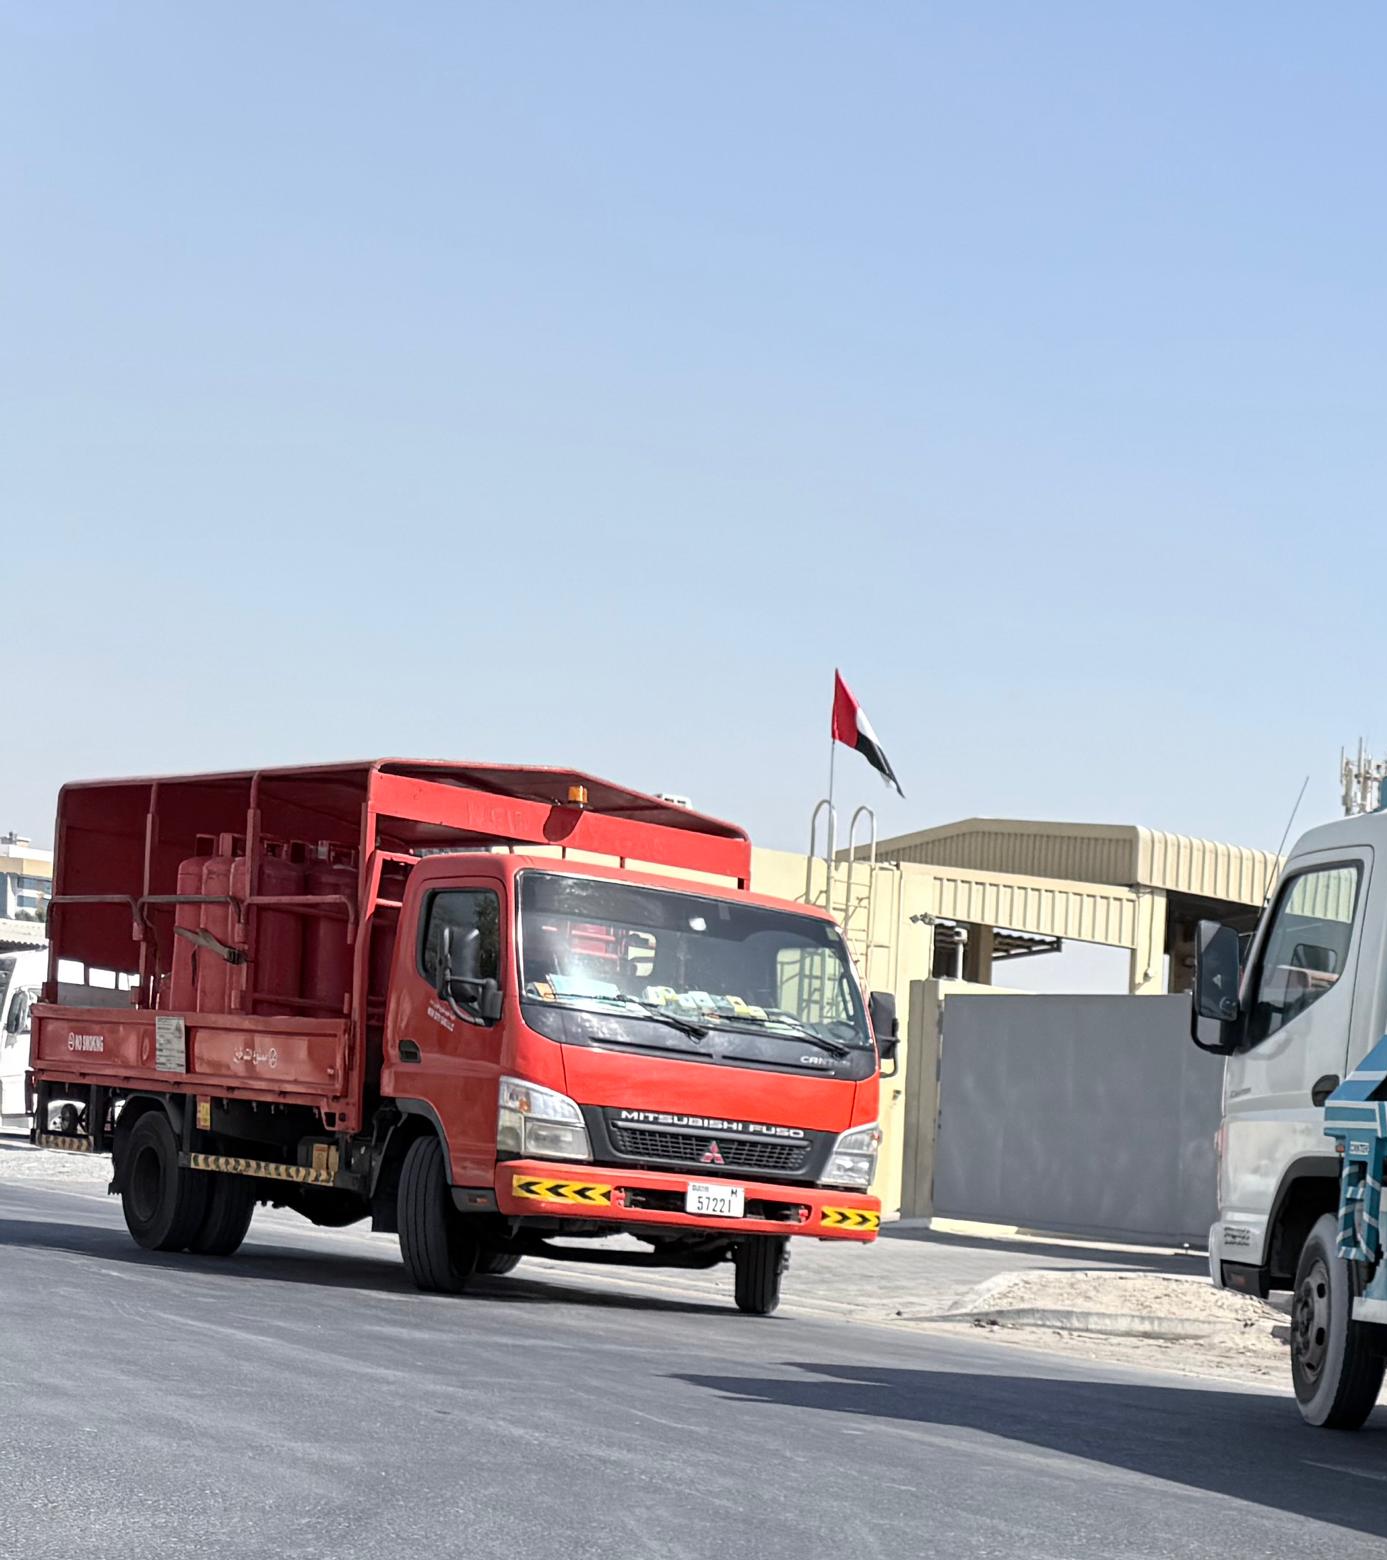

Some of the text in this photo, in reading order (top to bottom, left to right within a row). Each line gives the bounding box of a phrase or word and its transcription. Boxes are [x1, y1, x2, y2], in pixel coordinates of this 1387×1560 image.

[621, 1110, 804, 1138] MITSUBISHI FUSO
[697, 1195, 731, 1213] 57221
